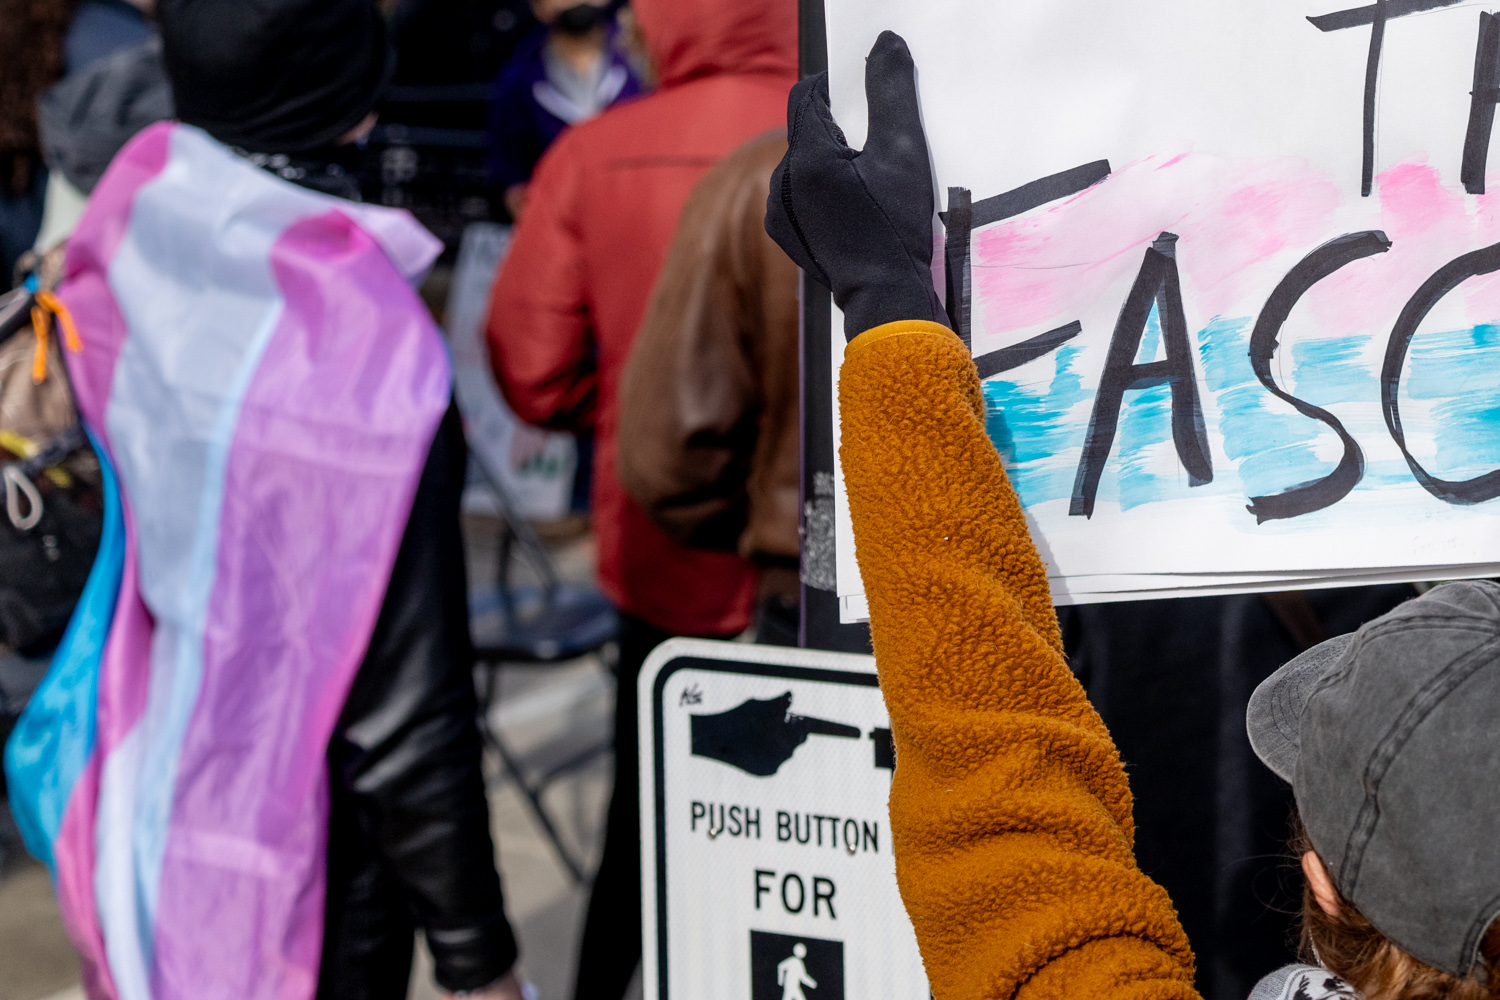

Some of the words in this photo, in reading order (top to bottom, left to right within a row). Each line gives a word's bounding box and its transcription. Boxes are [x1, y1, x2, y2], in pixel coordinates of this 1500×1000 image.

[691, 801, 761, 840] PUSH
[776, 810, 880, 855] BUTTON
[754, 868, 837, 920] FOR
